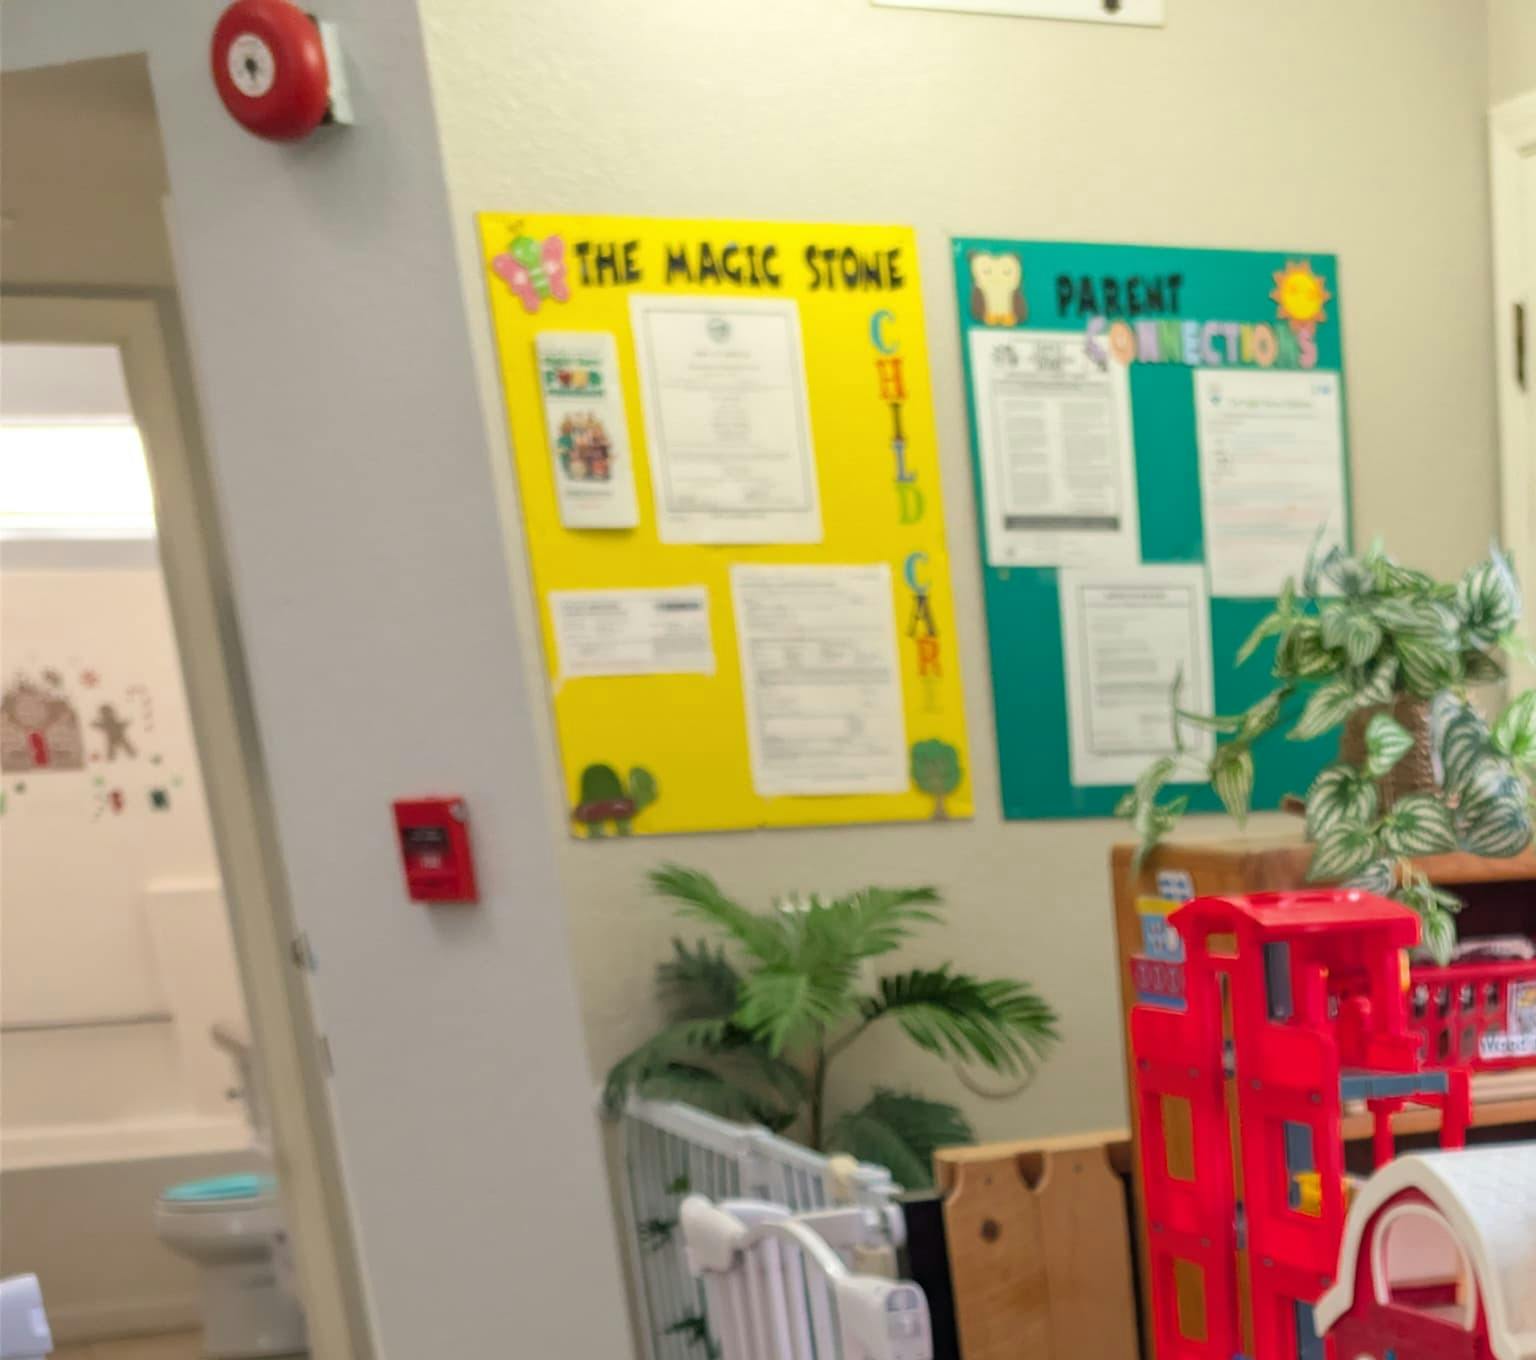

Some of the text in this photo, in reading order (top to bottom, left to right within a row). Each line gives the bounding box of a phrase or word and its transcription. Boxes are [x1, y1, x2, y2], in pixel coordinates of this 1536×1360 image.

[574, 240, 906, 292] THE MAGIC STONE
[1056, 274, 1184, 317] PARENT
[1085, 316, 1319, 371] CONNECTIONS
[869, 310, 926, 526] CHILD
